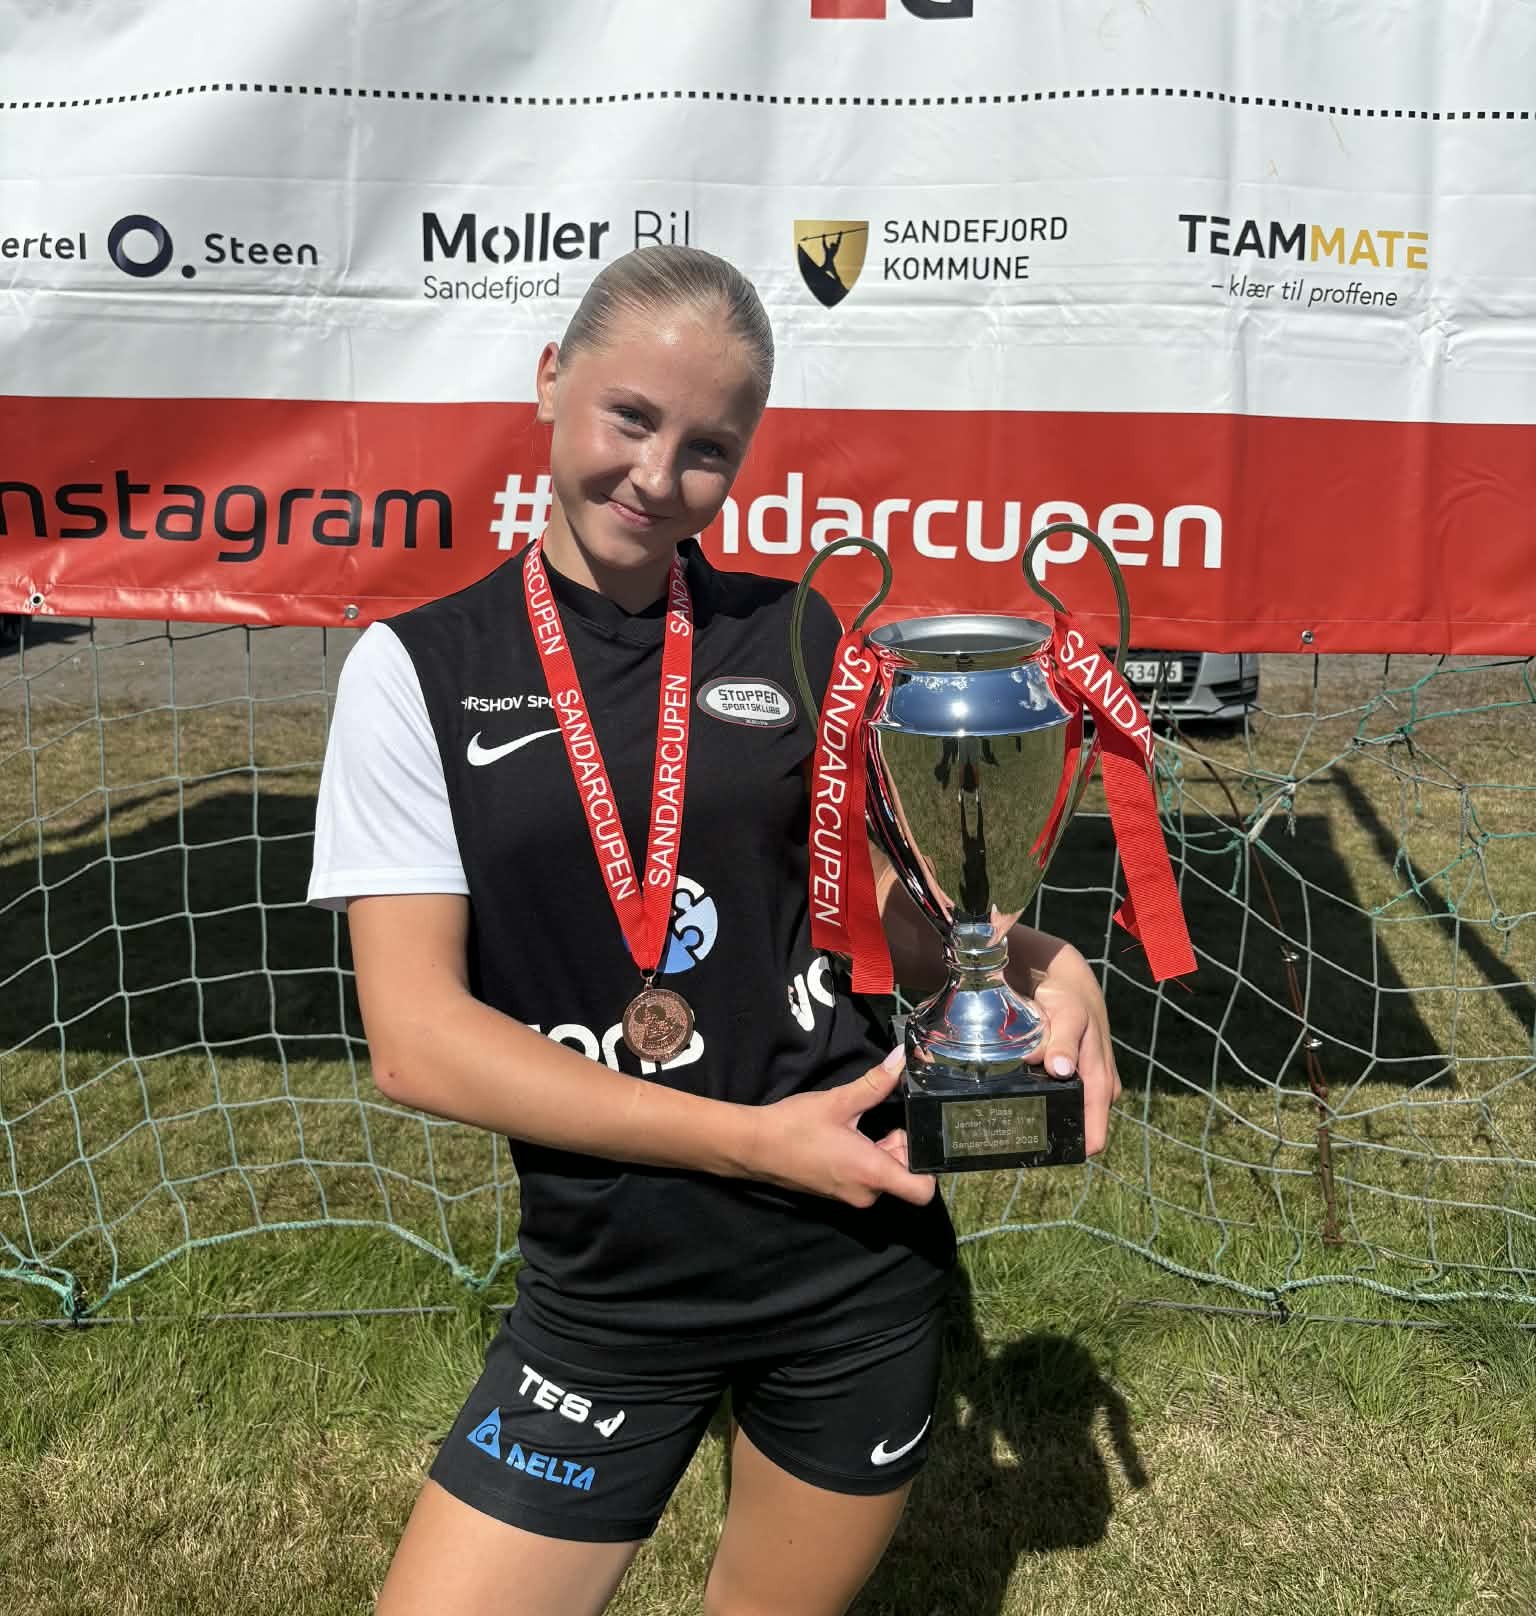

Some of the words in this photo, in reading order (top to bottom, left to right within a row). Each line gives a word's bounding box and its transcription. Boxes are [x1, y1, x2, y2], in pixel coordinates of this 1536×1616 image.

[204, 232, 319, 266] Steen
[634, 209, 690, 250] Bil
[883, 216, 1068, 244] SANDEFJORD
[1178, 213, 1429, 271] TEAMMATE
[423, 272, 560, 305] Sandefjord
[883, 256, 1030, 281] KOMMUNE
[1228, 274, 1275, 300] klær
[1281, 279, 1304, 301] til
[1308, 281, 1398, 308] proffene
[0, 469, 453, 563] nstagram
[556, 688, 638, 901] SANDARCUPEN
[649, 674, 688, 888] SANDARCUPEN
[813, 644, 872, 927] SANDARCUPEN
